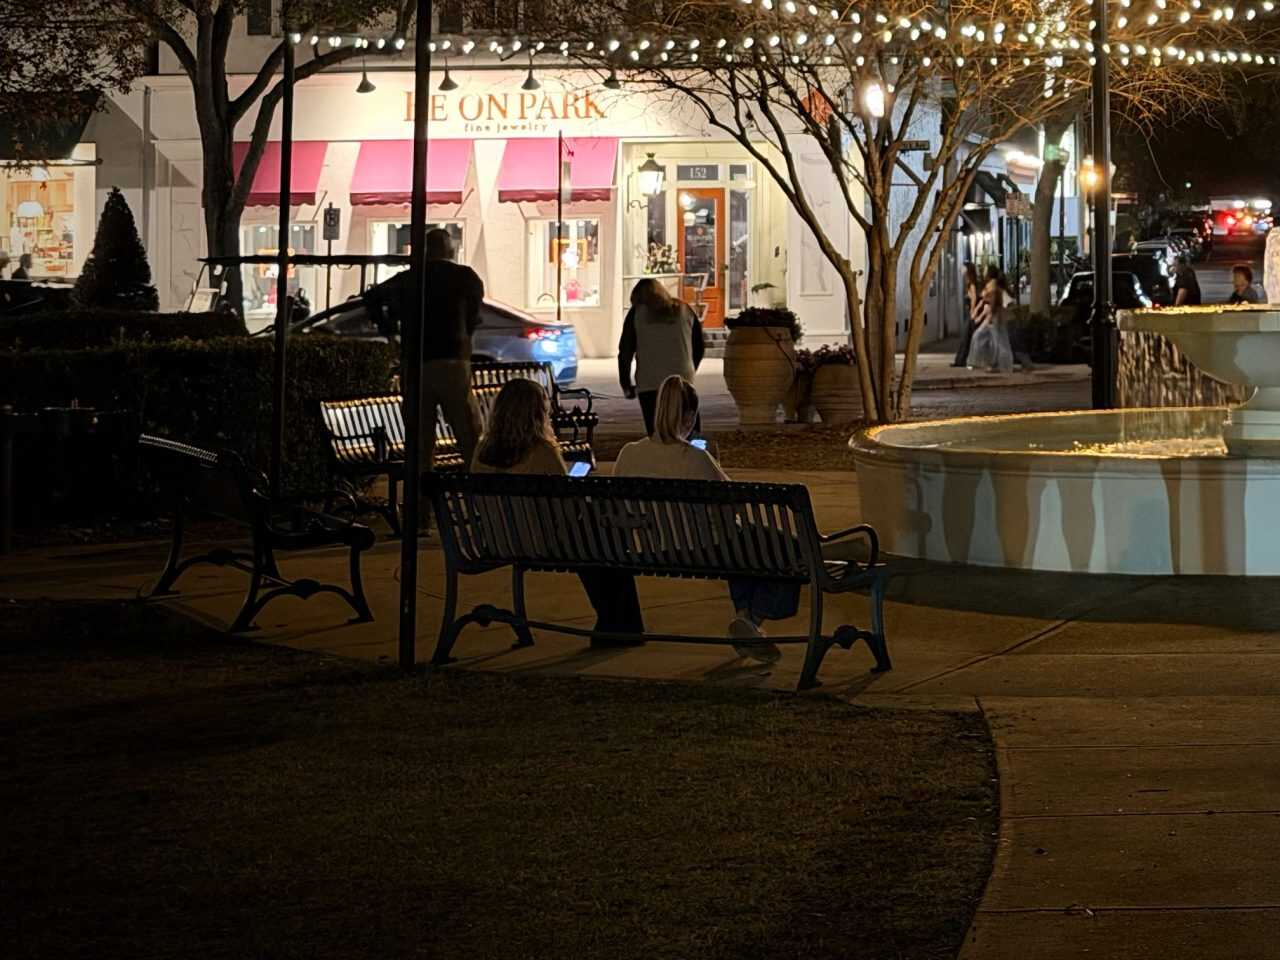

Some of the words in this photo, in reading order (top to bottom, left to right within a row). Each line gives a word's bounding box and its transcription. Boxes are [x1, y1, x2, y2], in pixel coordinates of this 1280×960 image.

[458, 93, 508, 121] ON
[519, 90, 608, 120] PARK
[464, 123, 491, 132] fine
[496, 123, 548, 133] jewelry
[690, 167, 707, 179] 152
